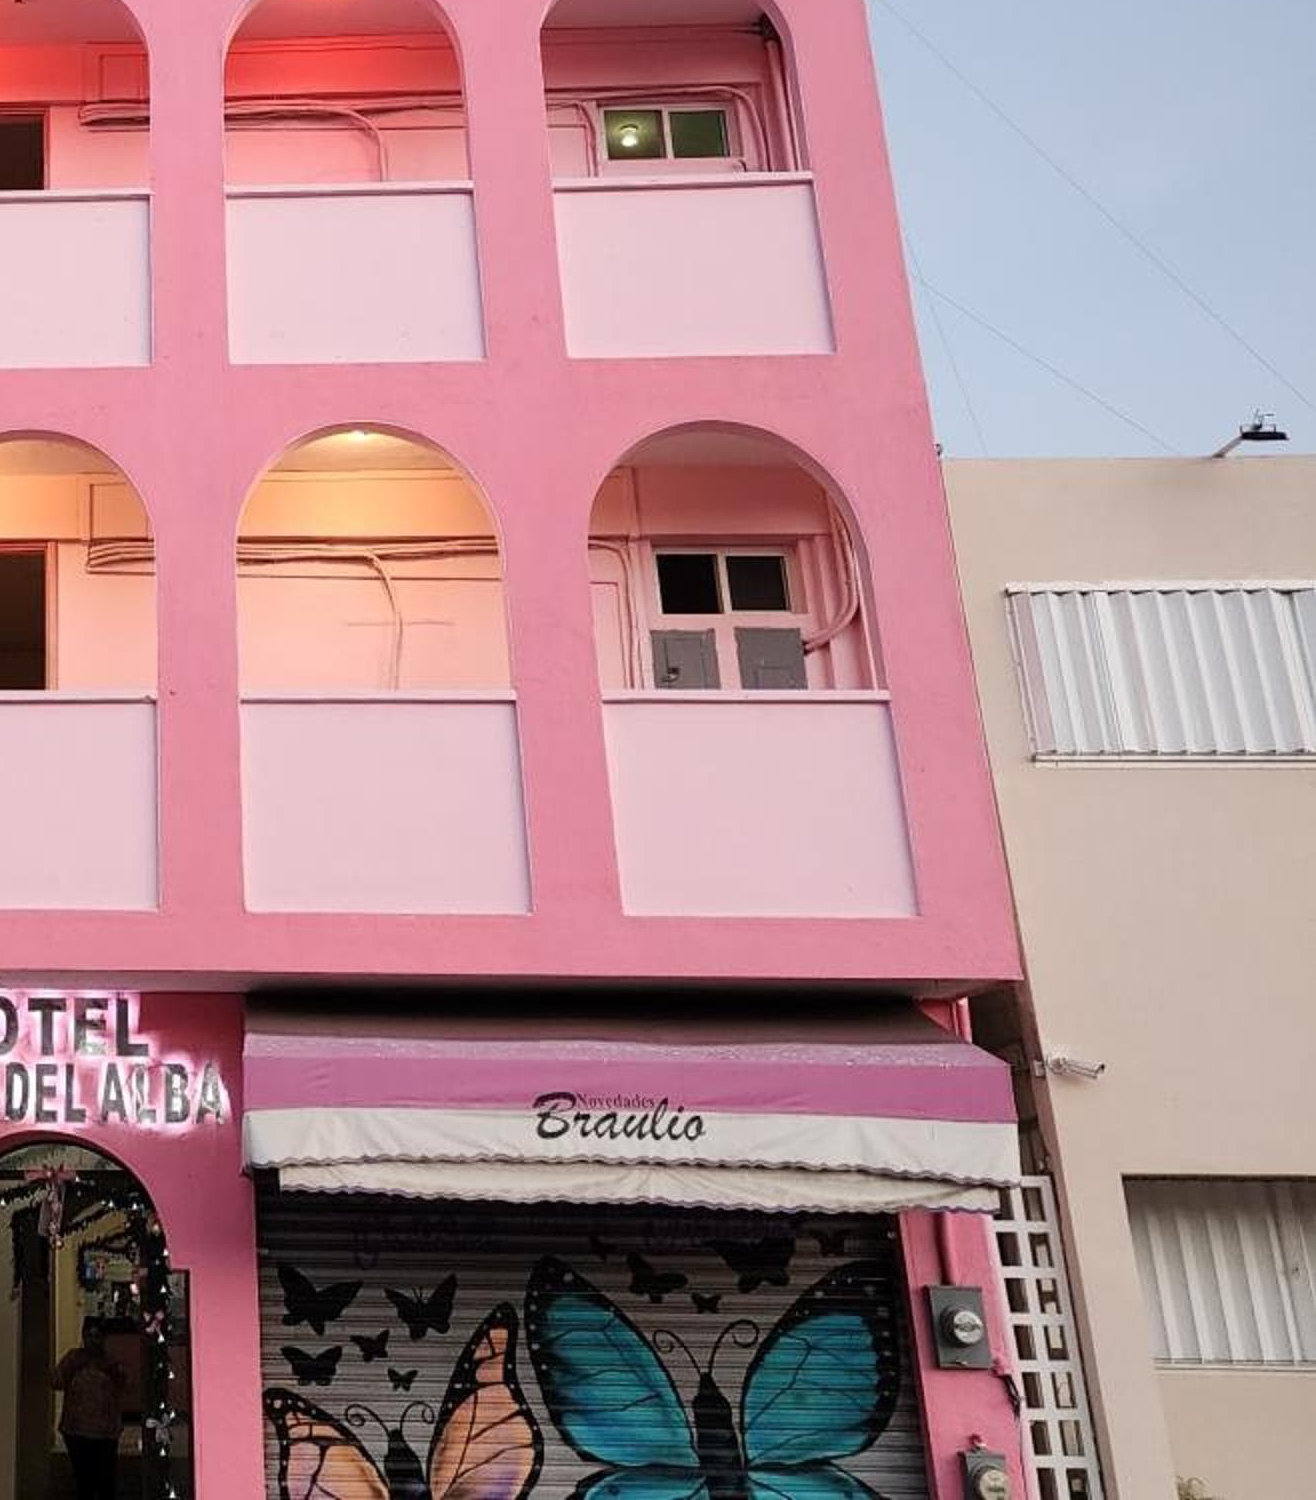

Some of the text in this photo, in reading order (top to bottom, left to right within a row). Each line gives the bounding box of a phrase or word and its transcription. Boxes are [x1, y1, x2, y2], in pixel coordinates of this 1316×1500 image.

[4, 1061, 87, 1123] DEL
[99, 1060, 227, 1124] ALBA
[531, 1091, 707, 1141] Braulio
[576, 1092, 655, 1110] Novedades
